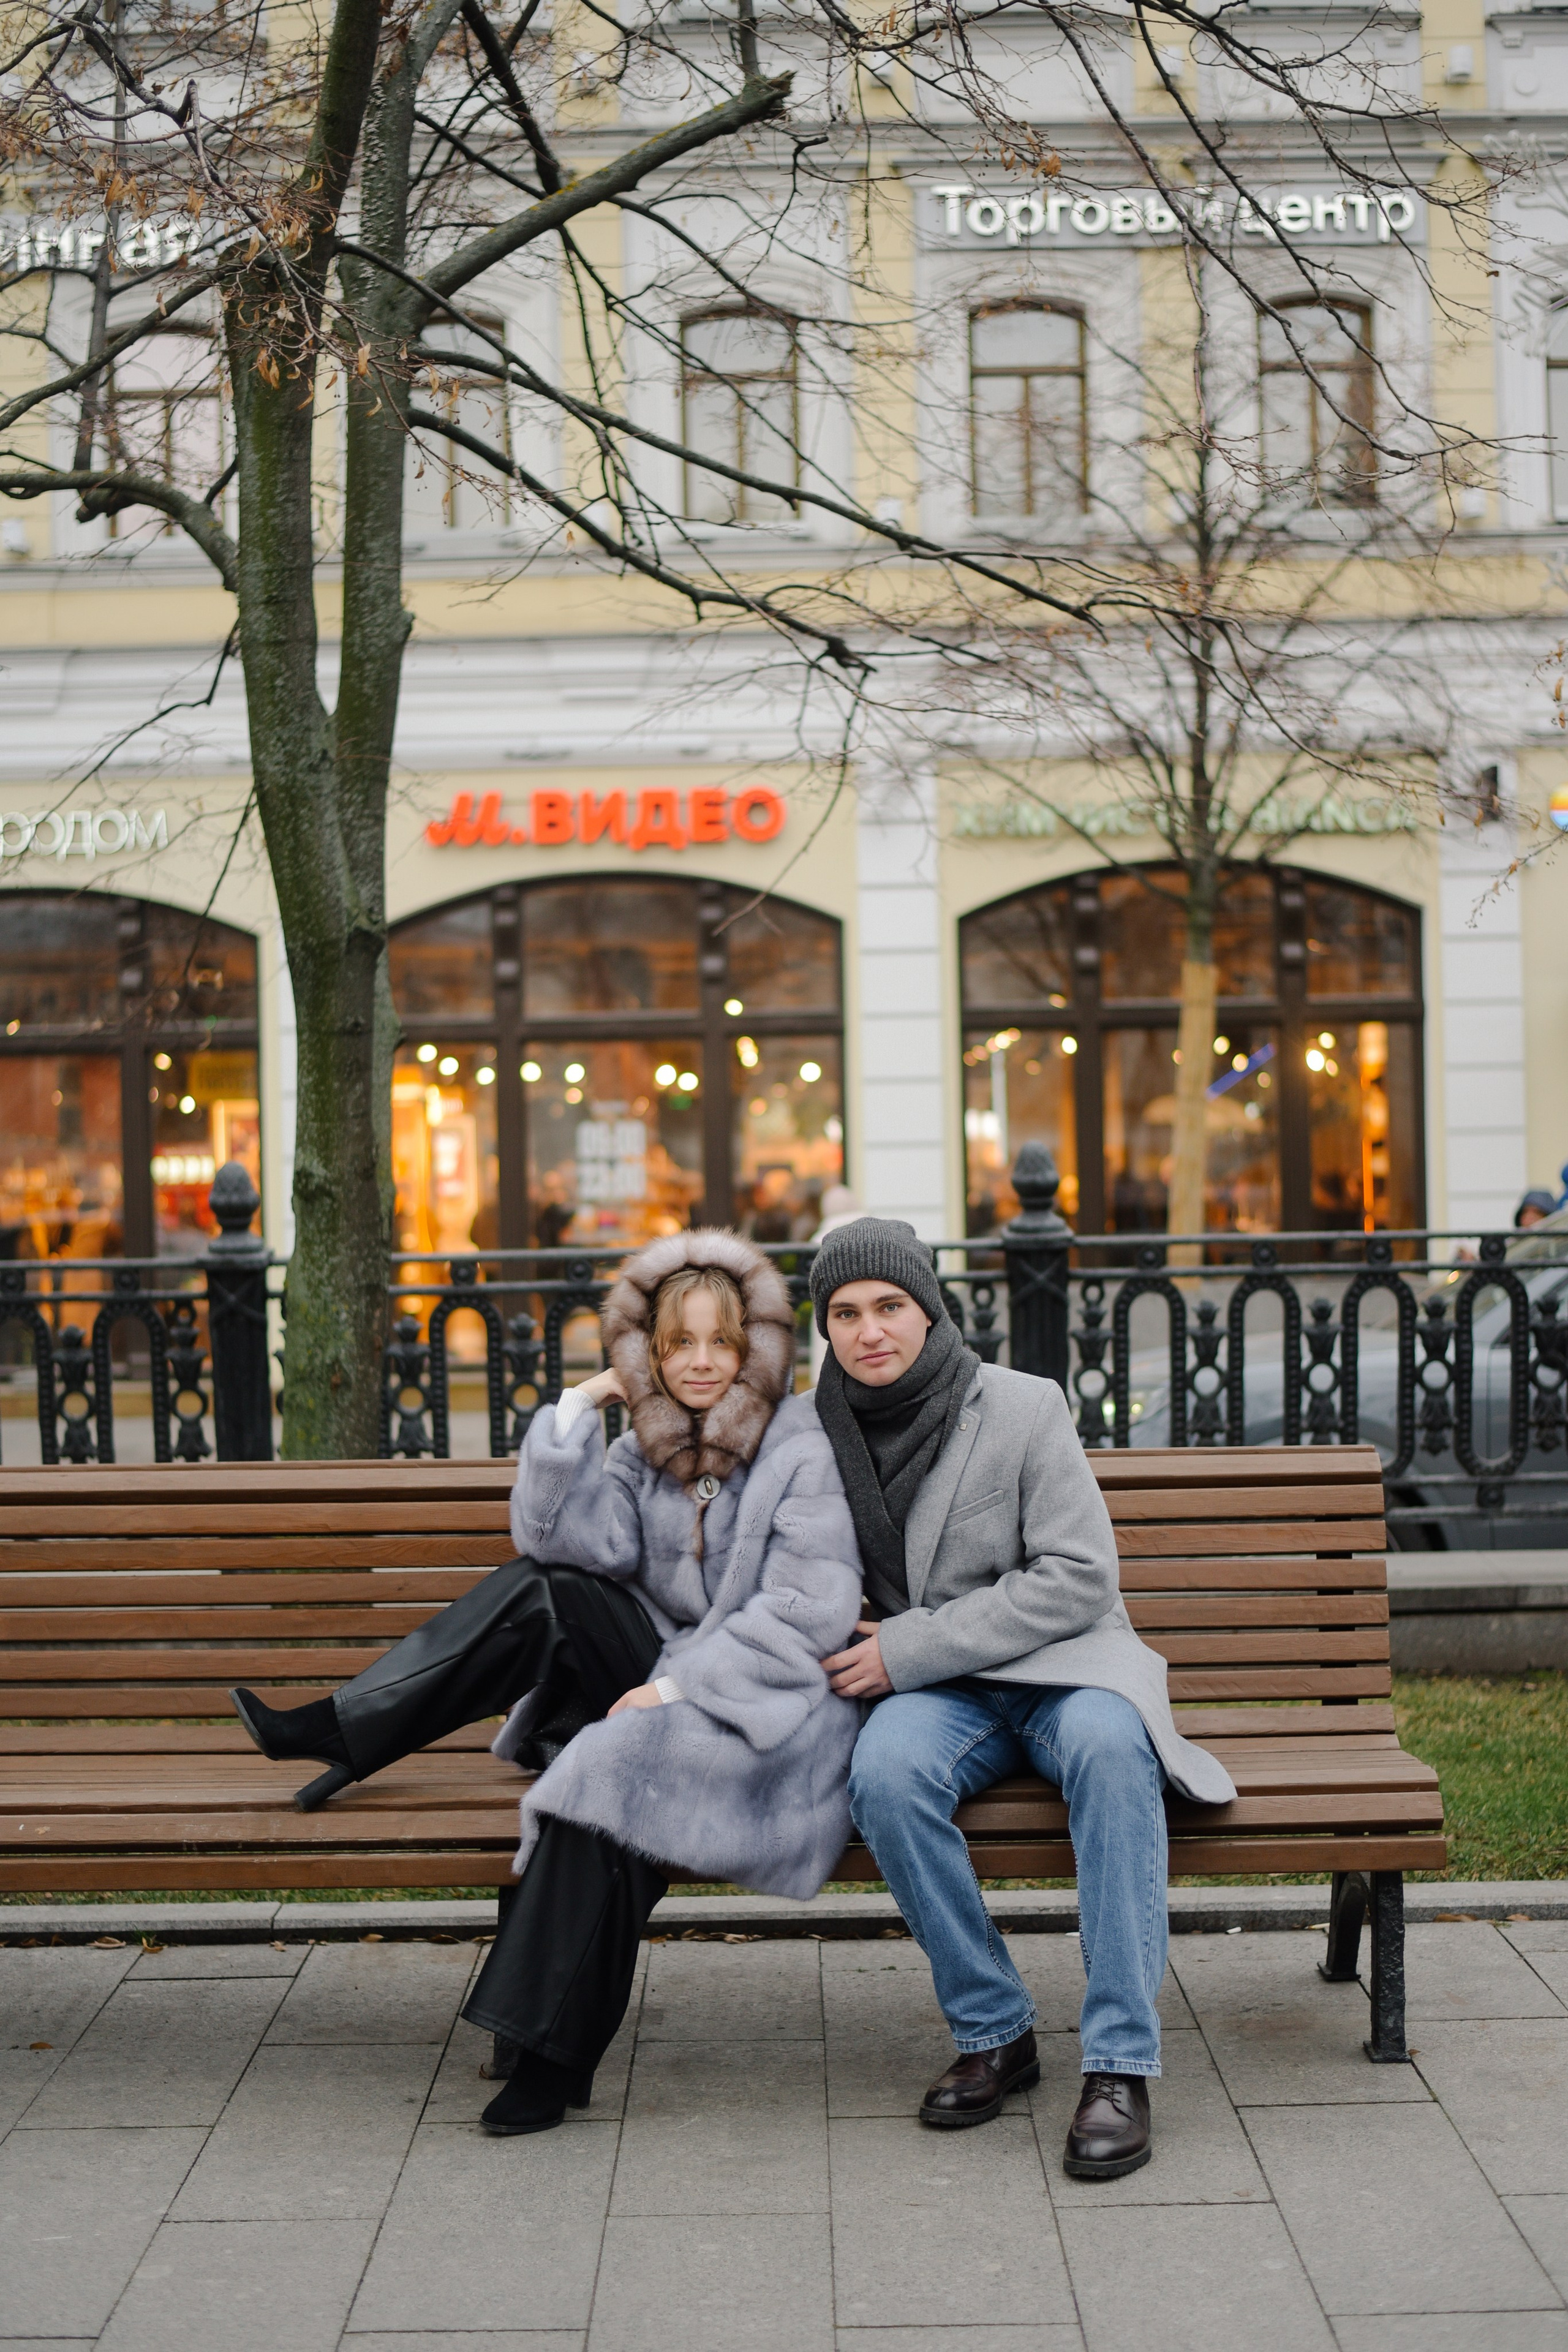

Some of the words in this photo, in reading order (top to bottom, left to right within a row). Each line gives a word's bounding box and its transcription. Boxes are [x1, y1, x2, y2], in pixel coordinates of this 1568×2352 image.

[930, 183, 1224, 246] Торговый
[1237, 191, 1417, 243] центр
[426, 786, 786, 851] М.ВИДЕО
